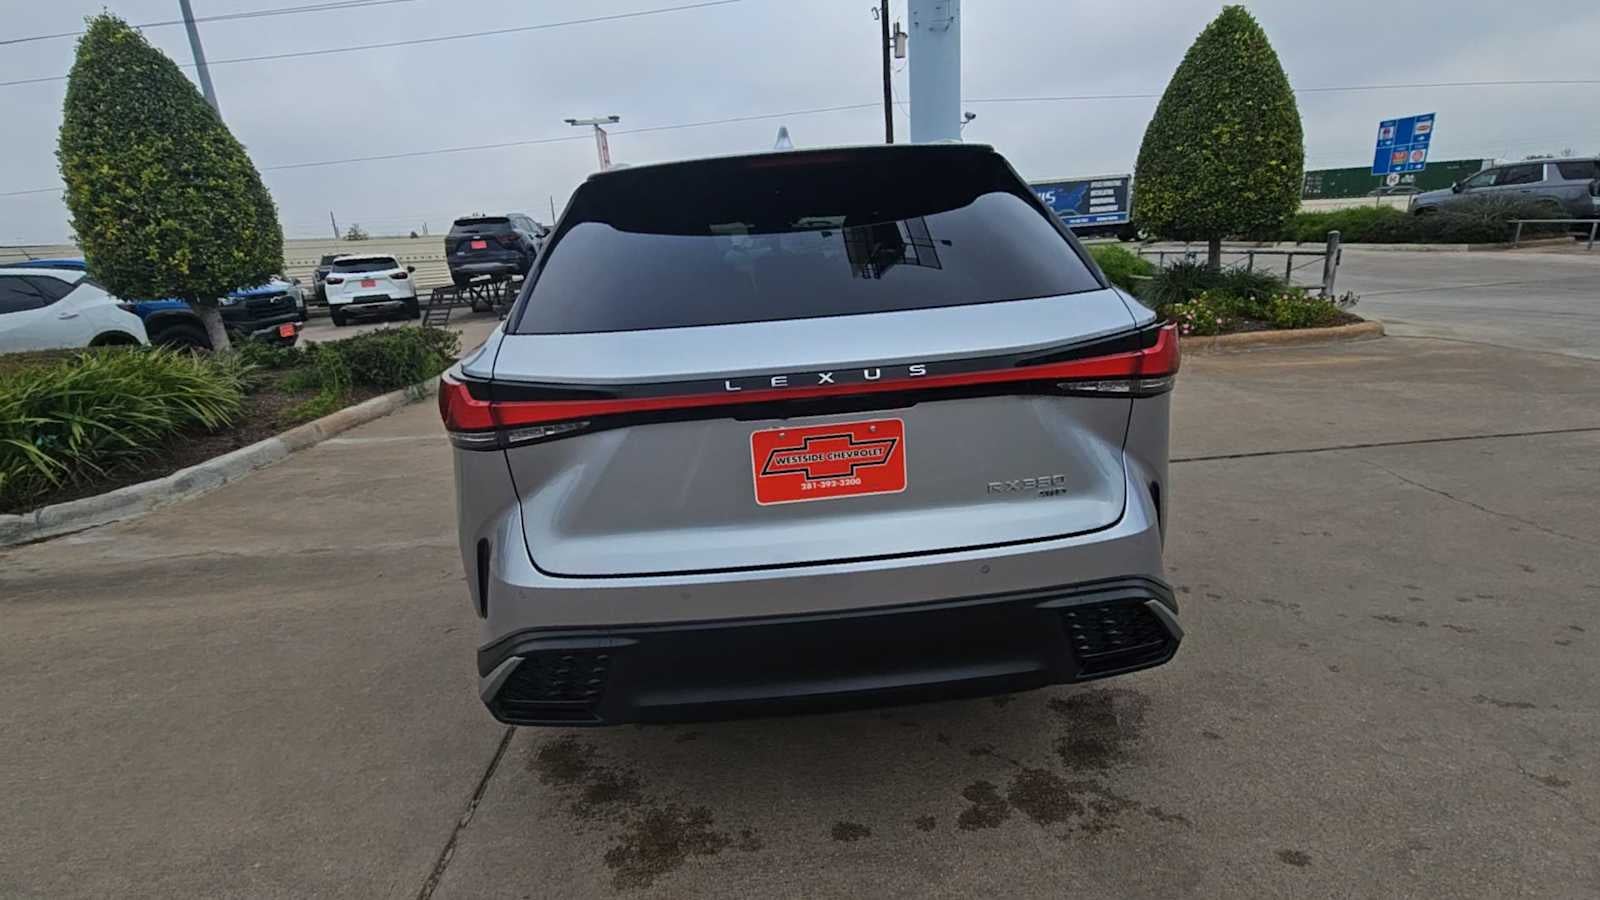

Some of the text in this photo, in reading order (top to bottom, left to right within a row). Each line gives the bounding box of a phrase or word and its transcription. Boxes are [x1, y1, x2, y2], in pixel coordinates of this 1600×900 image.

[725, 364, 927, 391] LEXUS
[776, 448, 884, 465] WESTSIDE CHEVROLET
[800, 478, 862, 491] 281-392-3200
